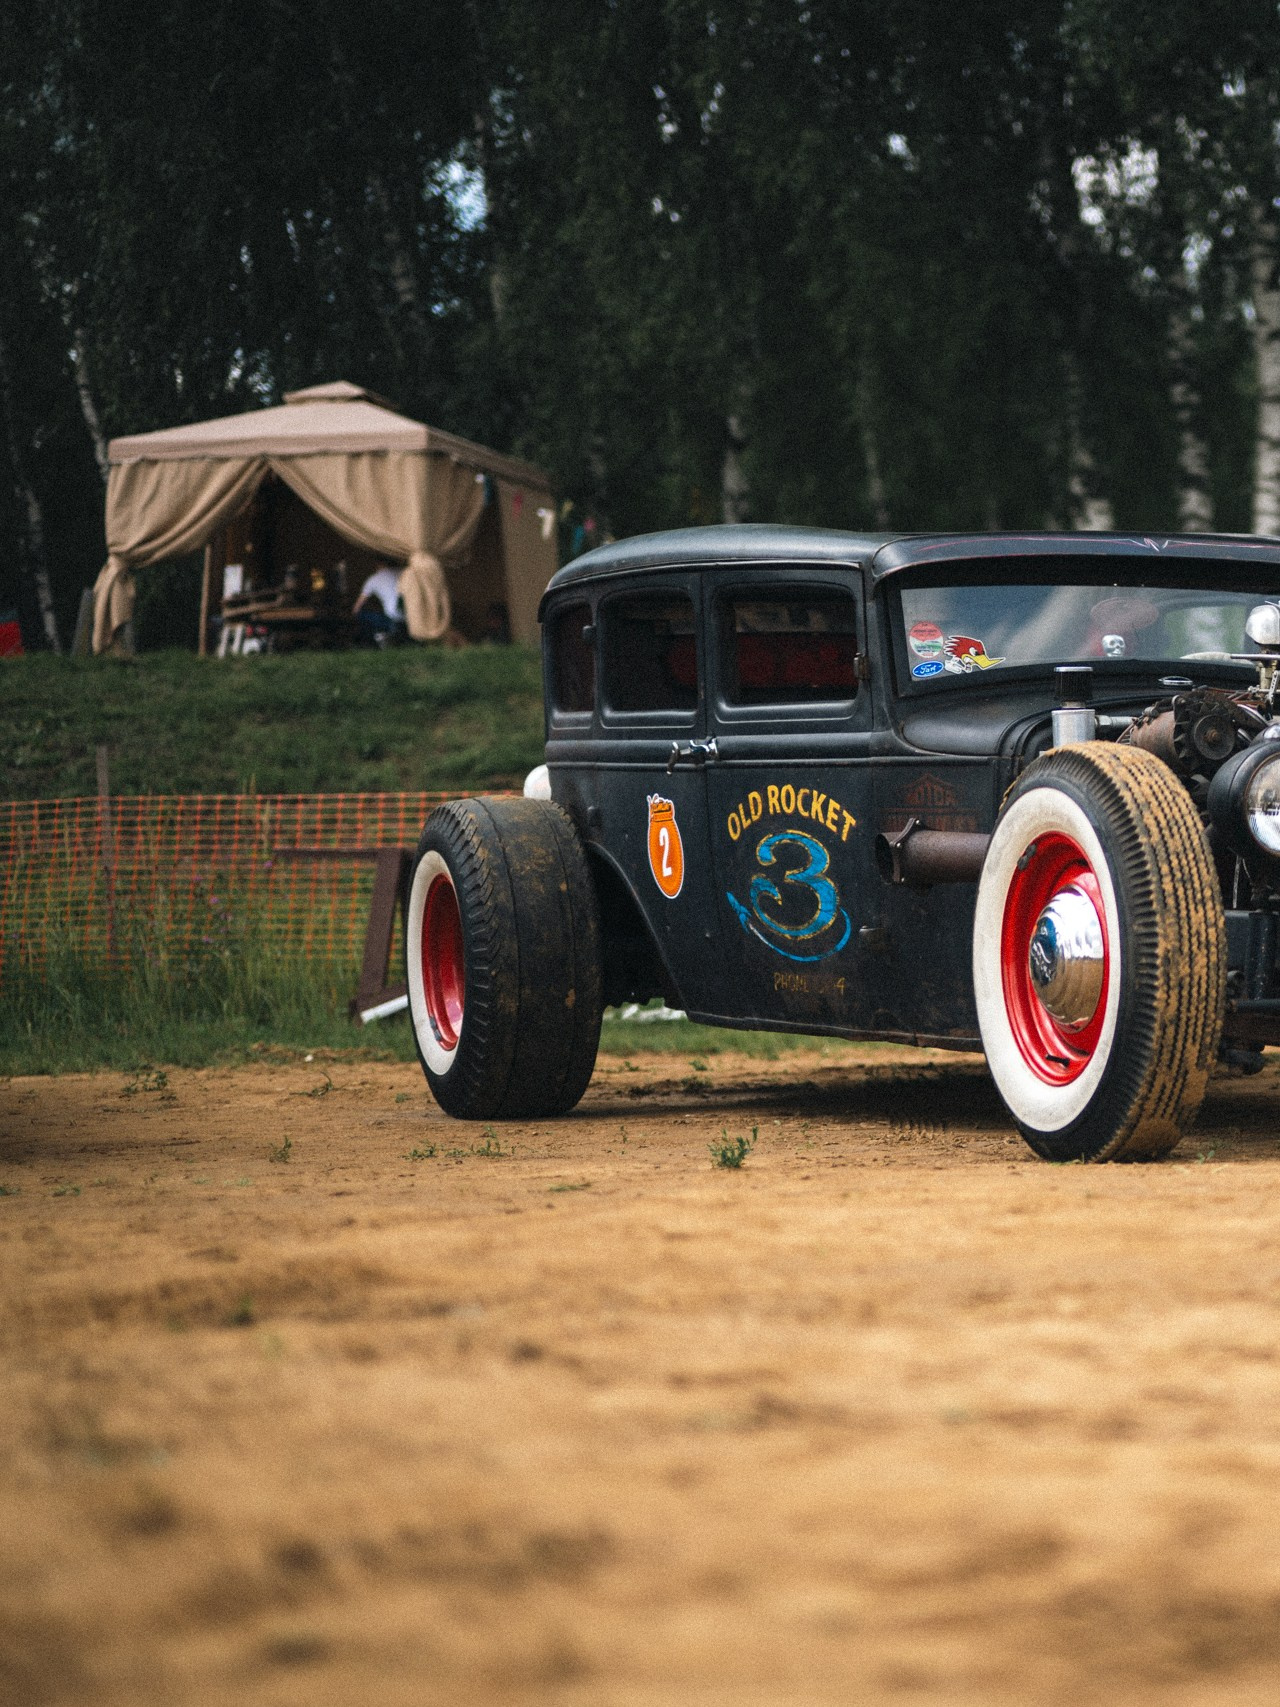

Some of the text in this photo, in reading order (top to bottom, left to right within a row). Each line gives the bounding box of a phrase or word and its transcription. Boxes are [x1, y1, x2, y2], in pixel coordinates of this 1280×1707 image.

[727, 784, 856, 842] OLD ROCKET
[659, 827, 672, 878] 2
[750, 829, 840, 939] 3
